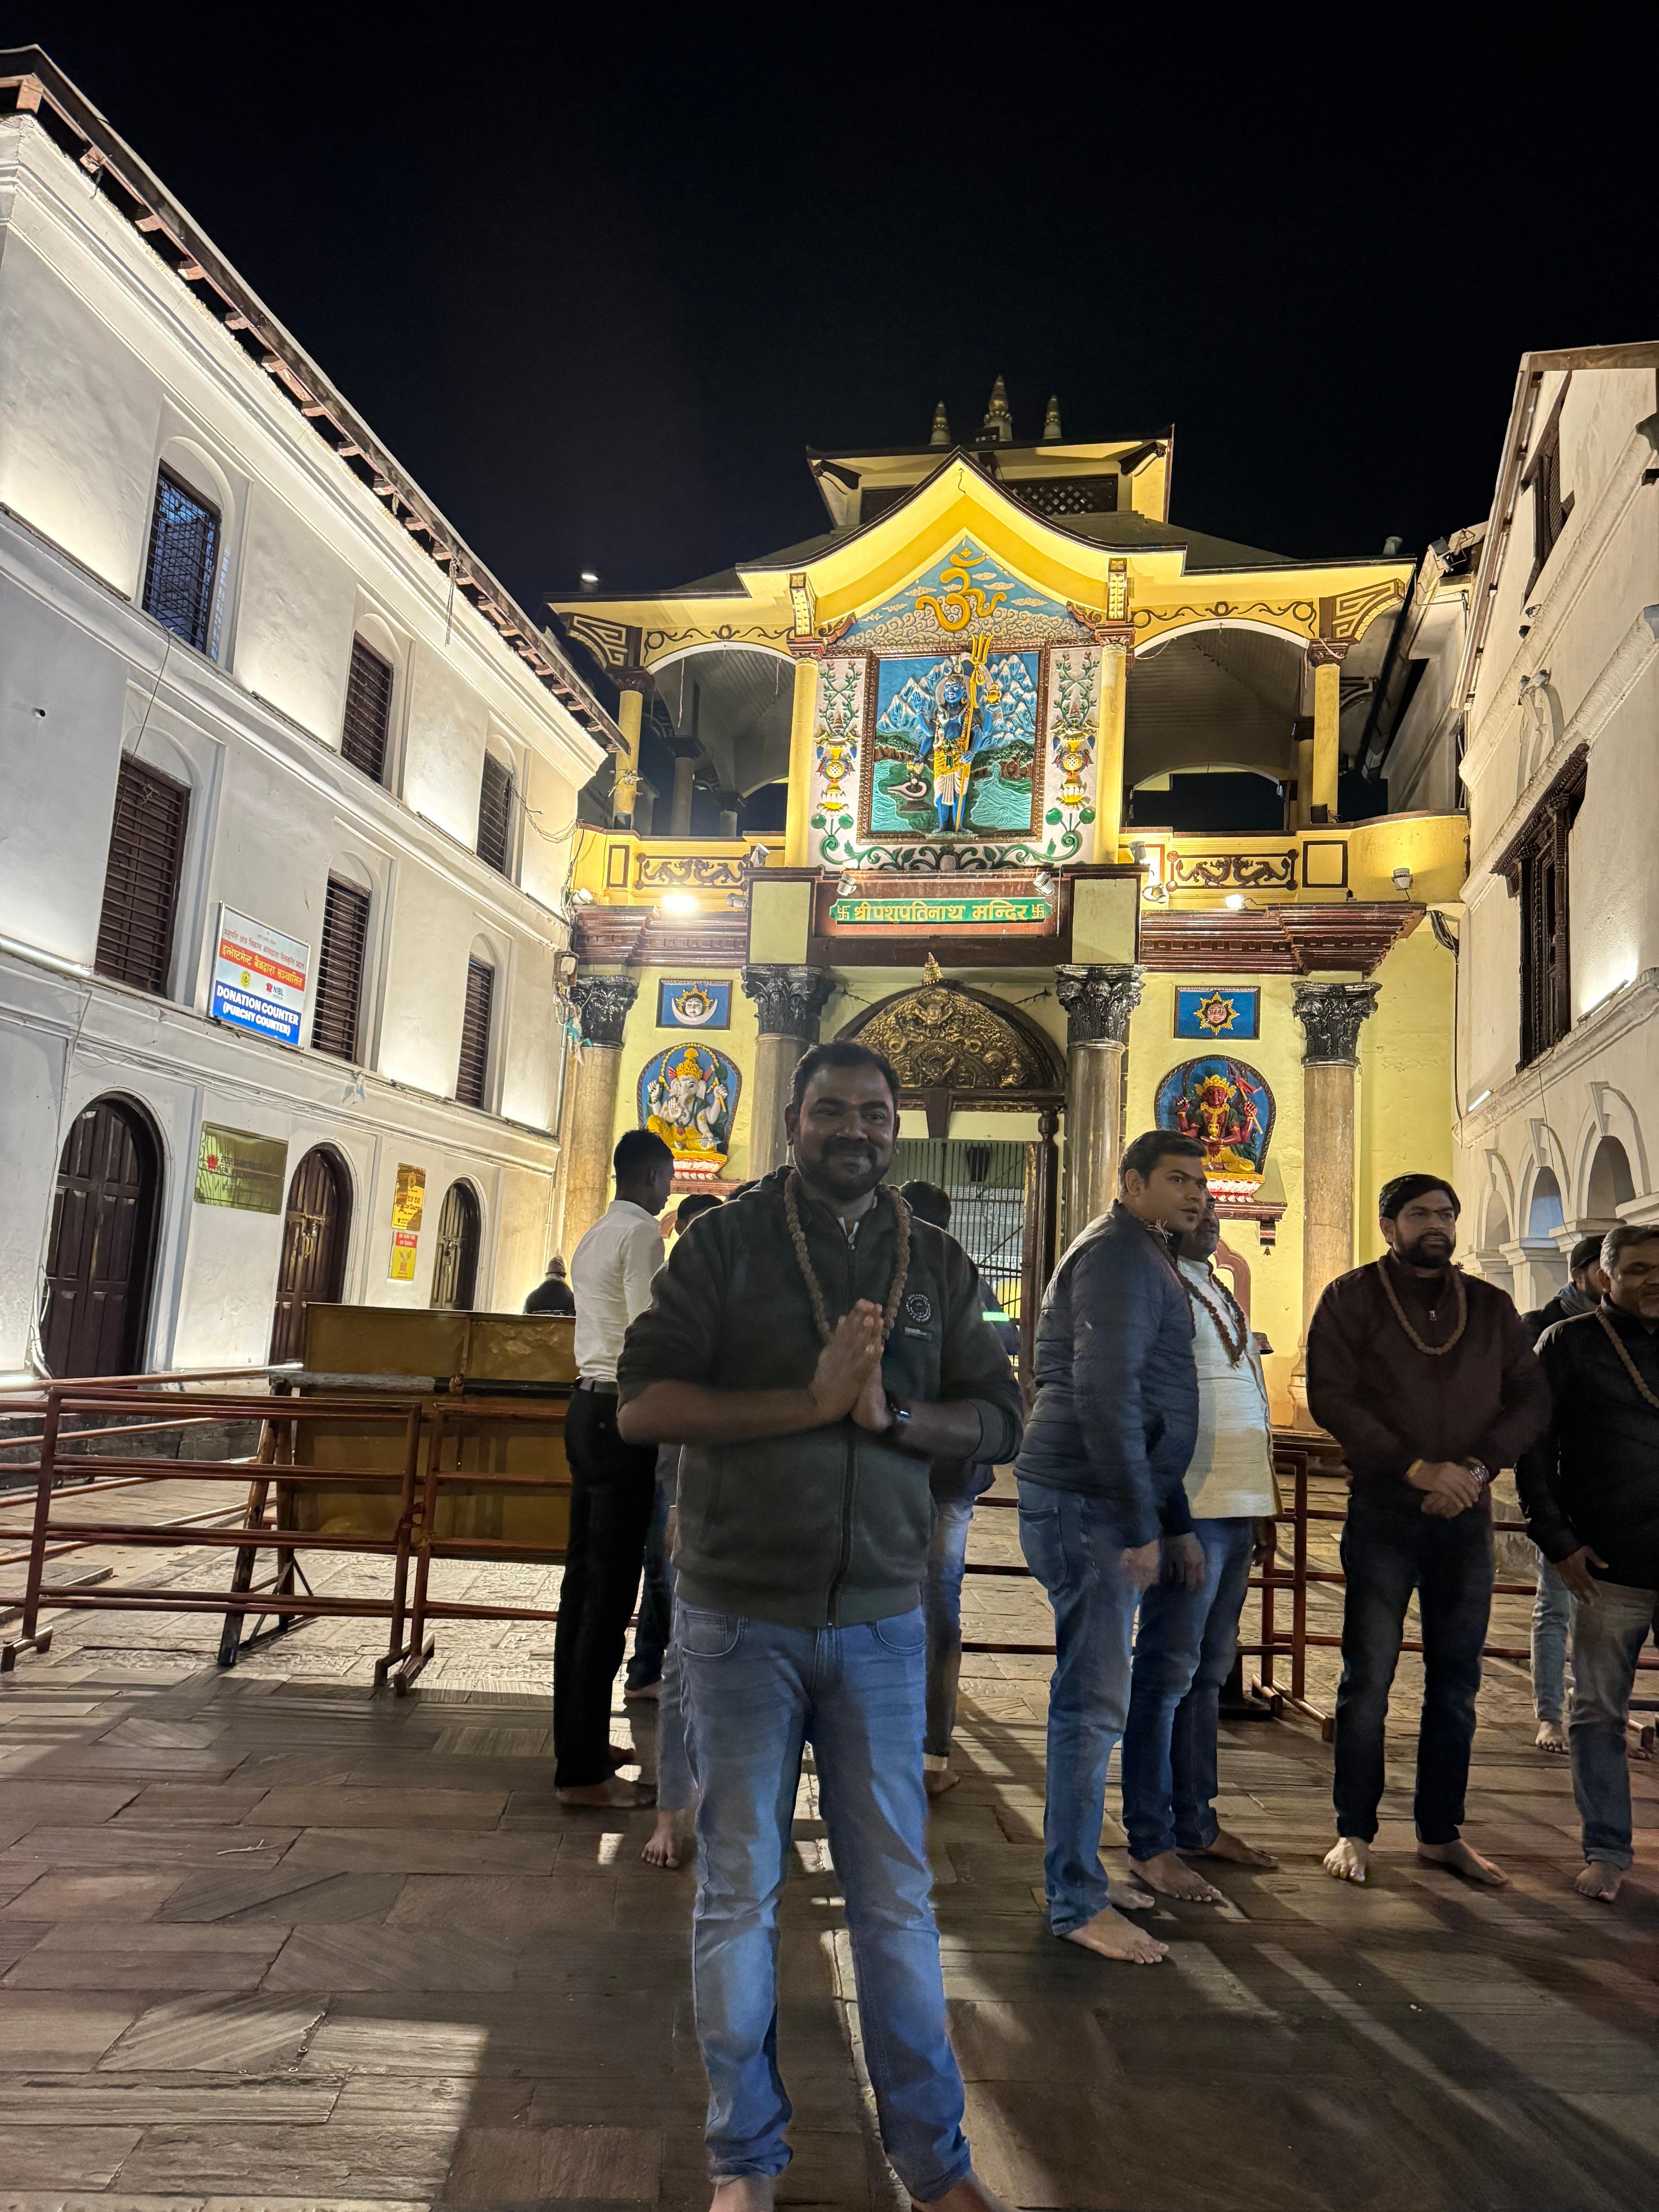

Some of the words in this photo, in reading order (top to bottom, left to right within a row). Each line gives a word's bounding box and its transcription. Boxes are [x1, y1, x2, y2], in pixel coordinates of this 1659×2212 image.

[972, 900, 1028, 922] मन्दिर
[216, 985, 262, 1012] DONATION
[261, 1002, 299, 1025] COUNTER
[273, 986, 283, 996] NIBL
[223, 1001, 256, 1022] (PURCHY
[256, 1014, 291, 1037] COUNTER)
